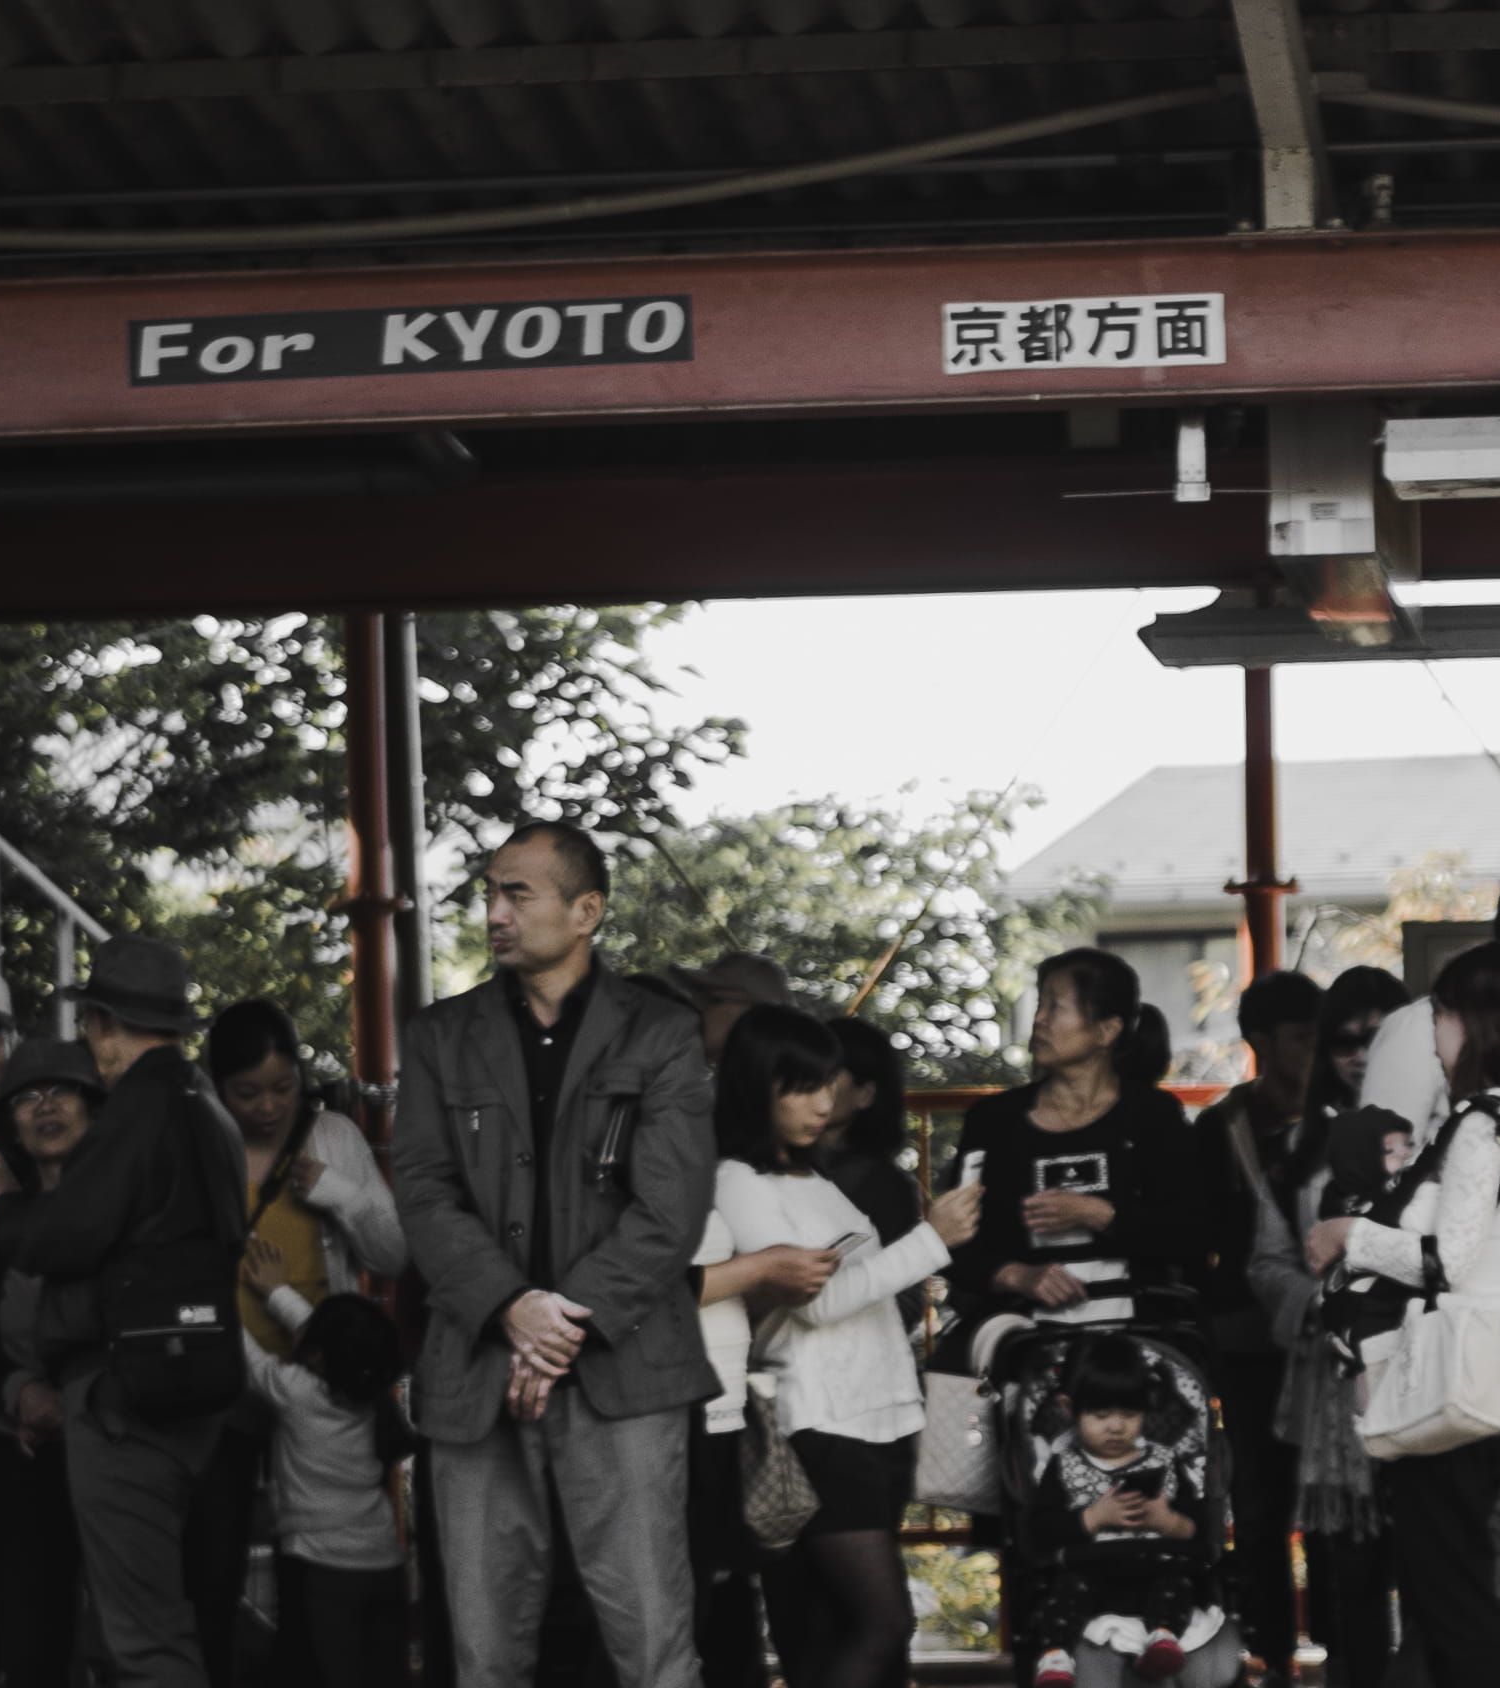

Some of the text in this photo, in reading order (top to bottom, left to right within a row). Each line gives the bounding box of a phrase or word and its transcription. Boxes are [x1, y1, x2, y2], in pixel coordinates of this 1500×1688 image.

[137, 299, 687, 379] For KYOTO
[950, 300, 1210, 365] 京都方面
